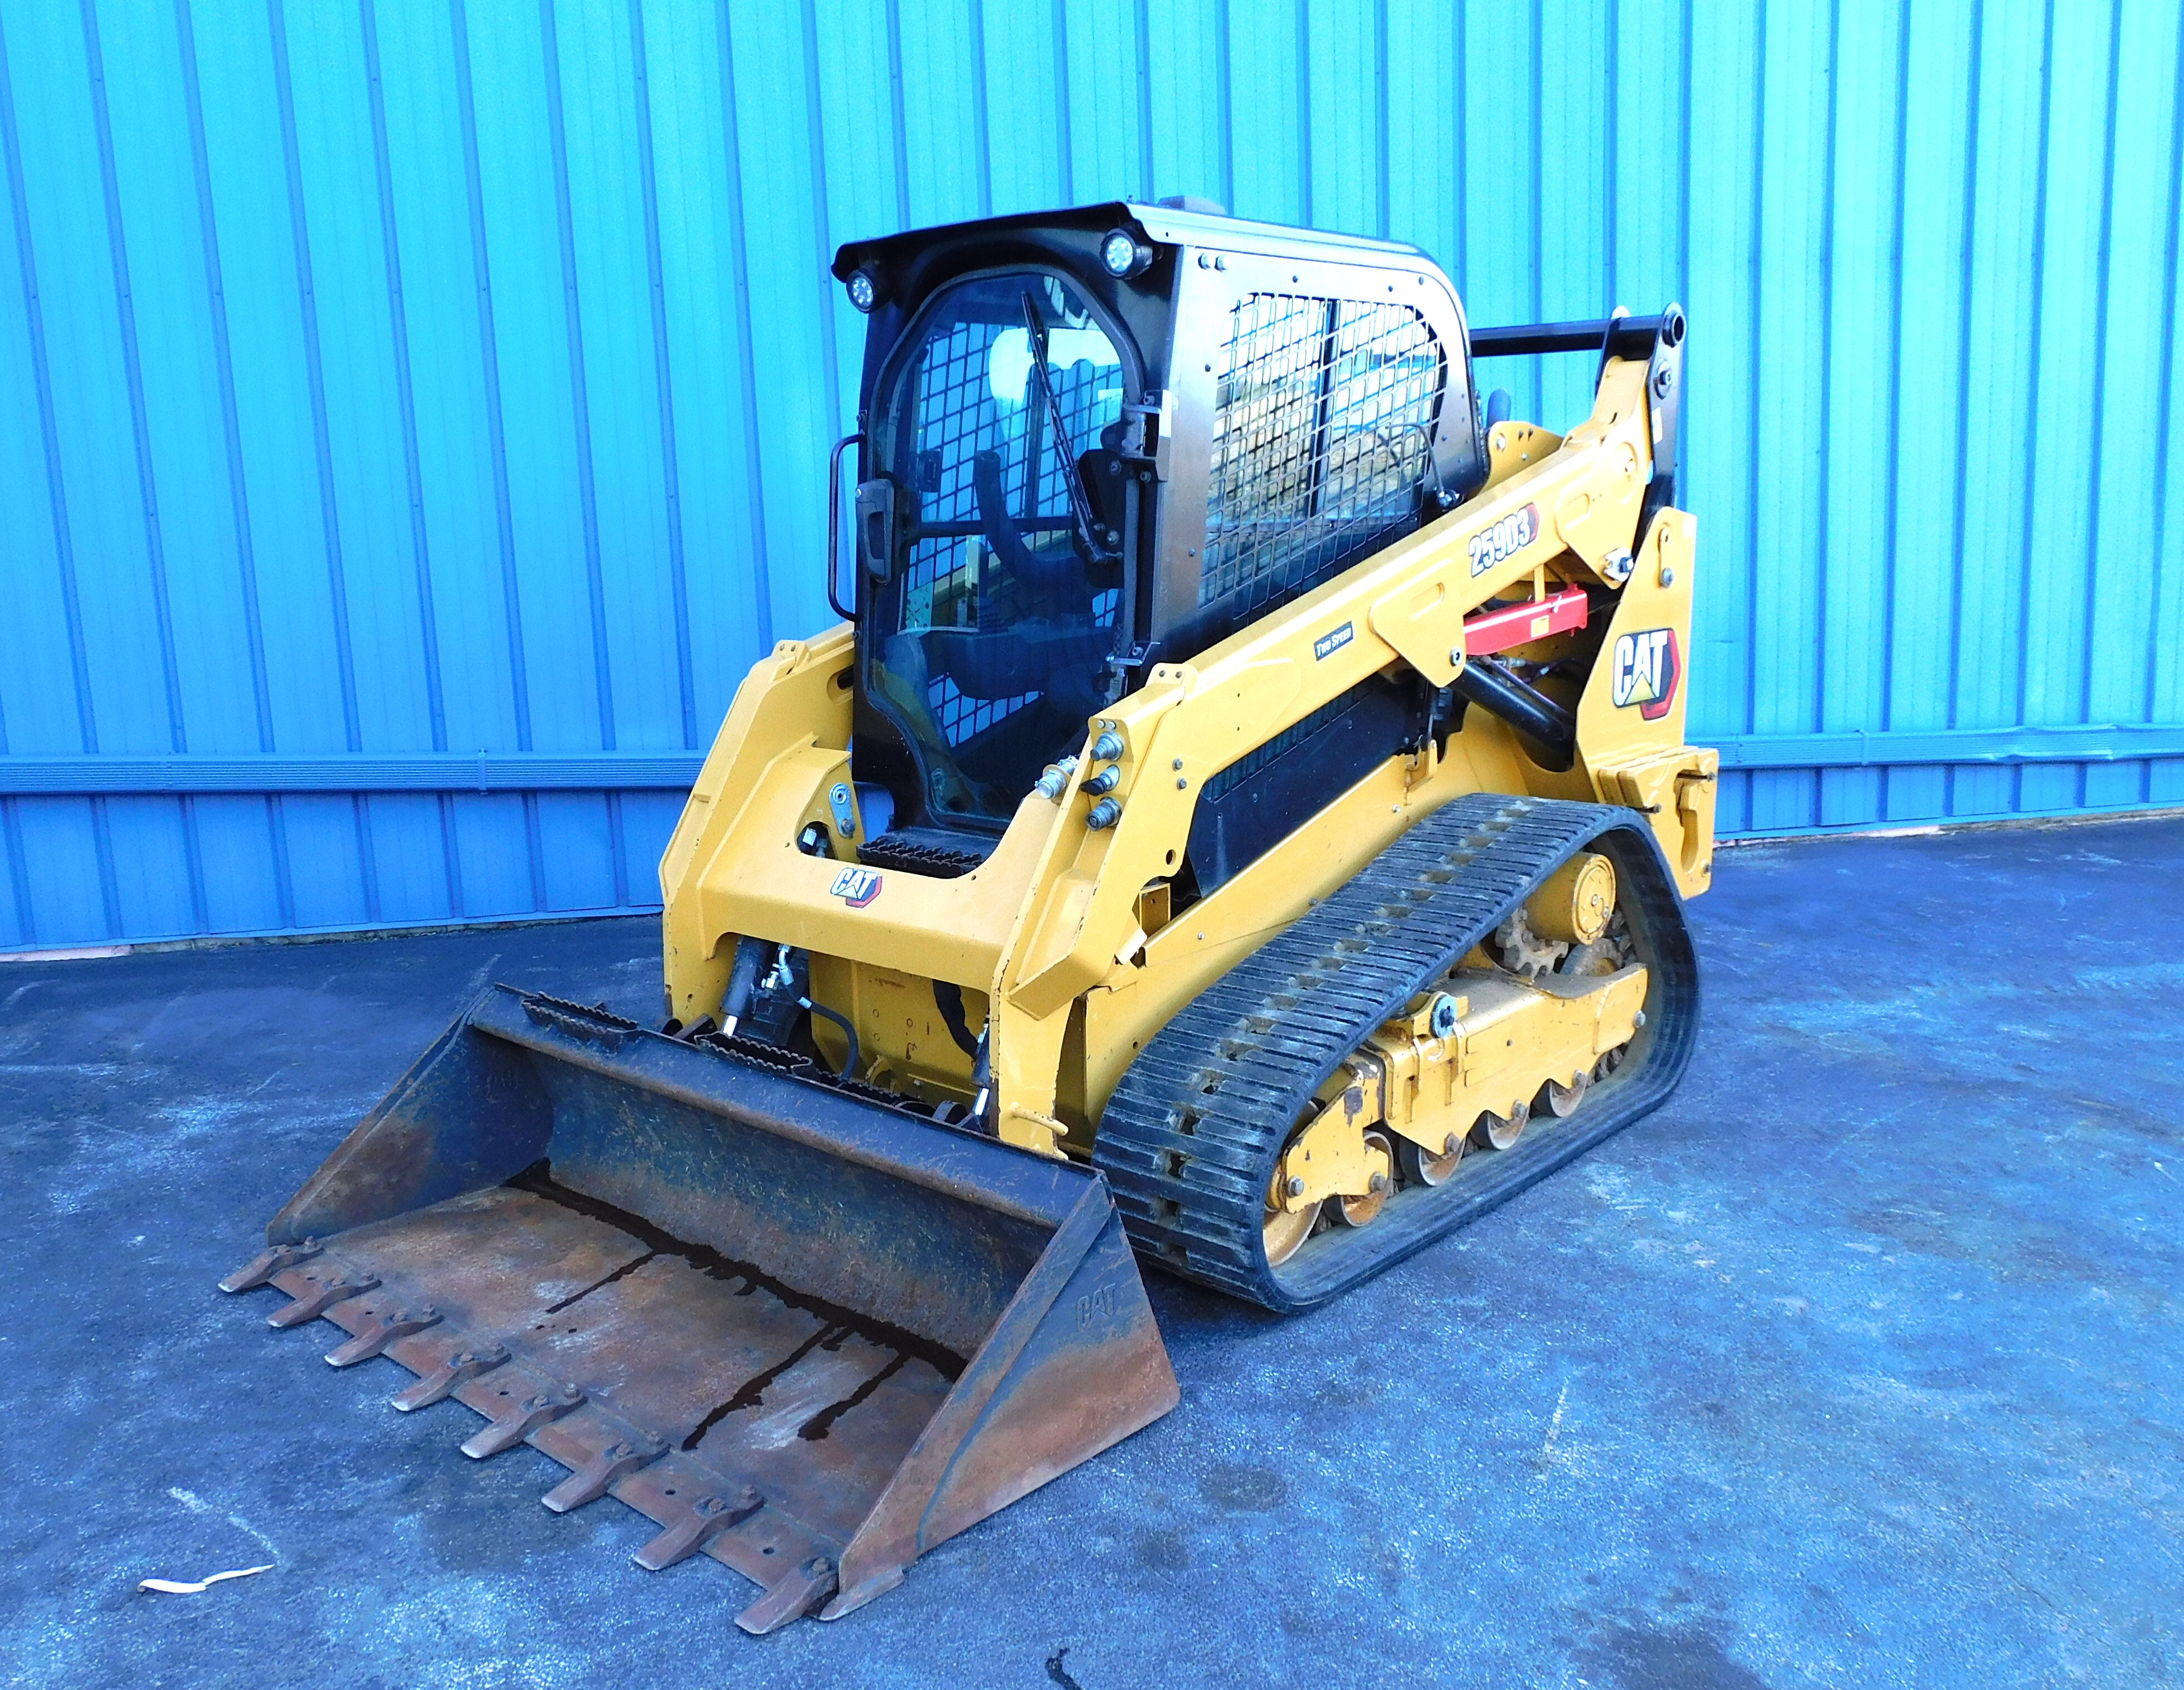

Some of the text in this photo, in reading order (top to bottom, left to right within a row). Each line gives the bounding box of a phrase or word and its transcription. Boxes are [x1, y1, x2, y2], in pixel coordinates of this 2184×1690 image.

[1469, 508, 1530, 577] 259D3
[1613, 630, 1668, 706] CAT
[831, 868, 878, 899] CAT
[1077, 1283, 1116, 1333] CAT
